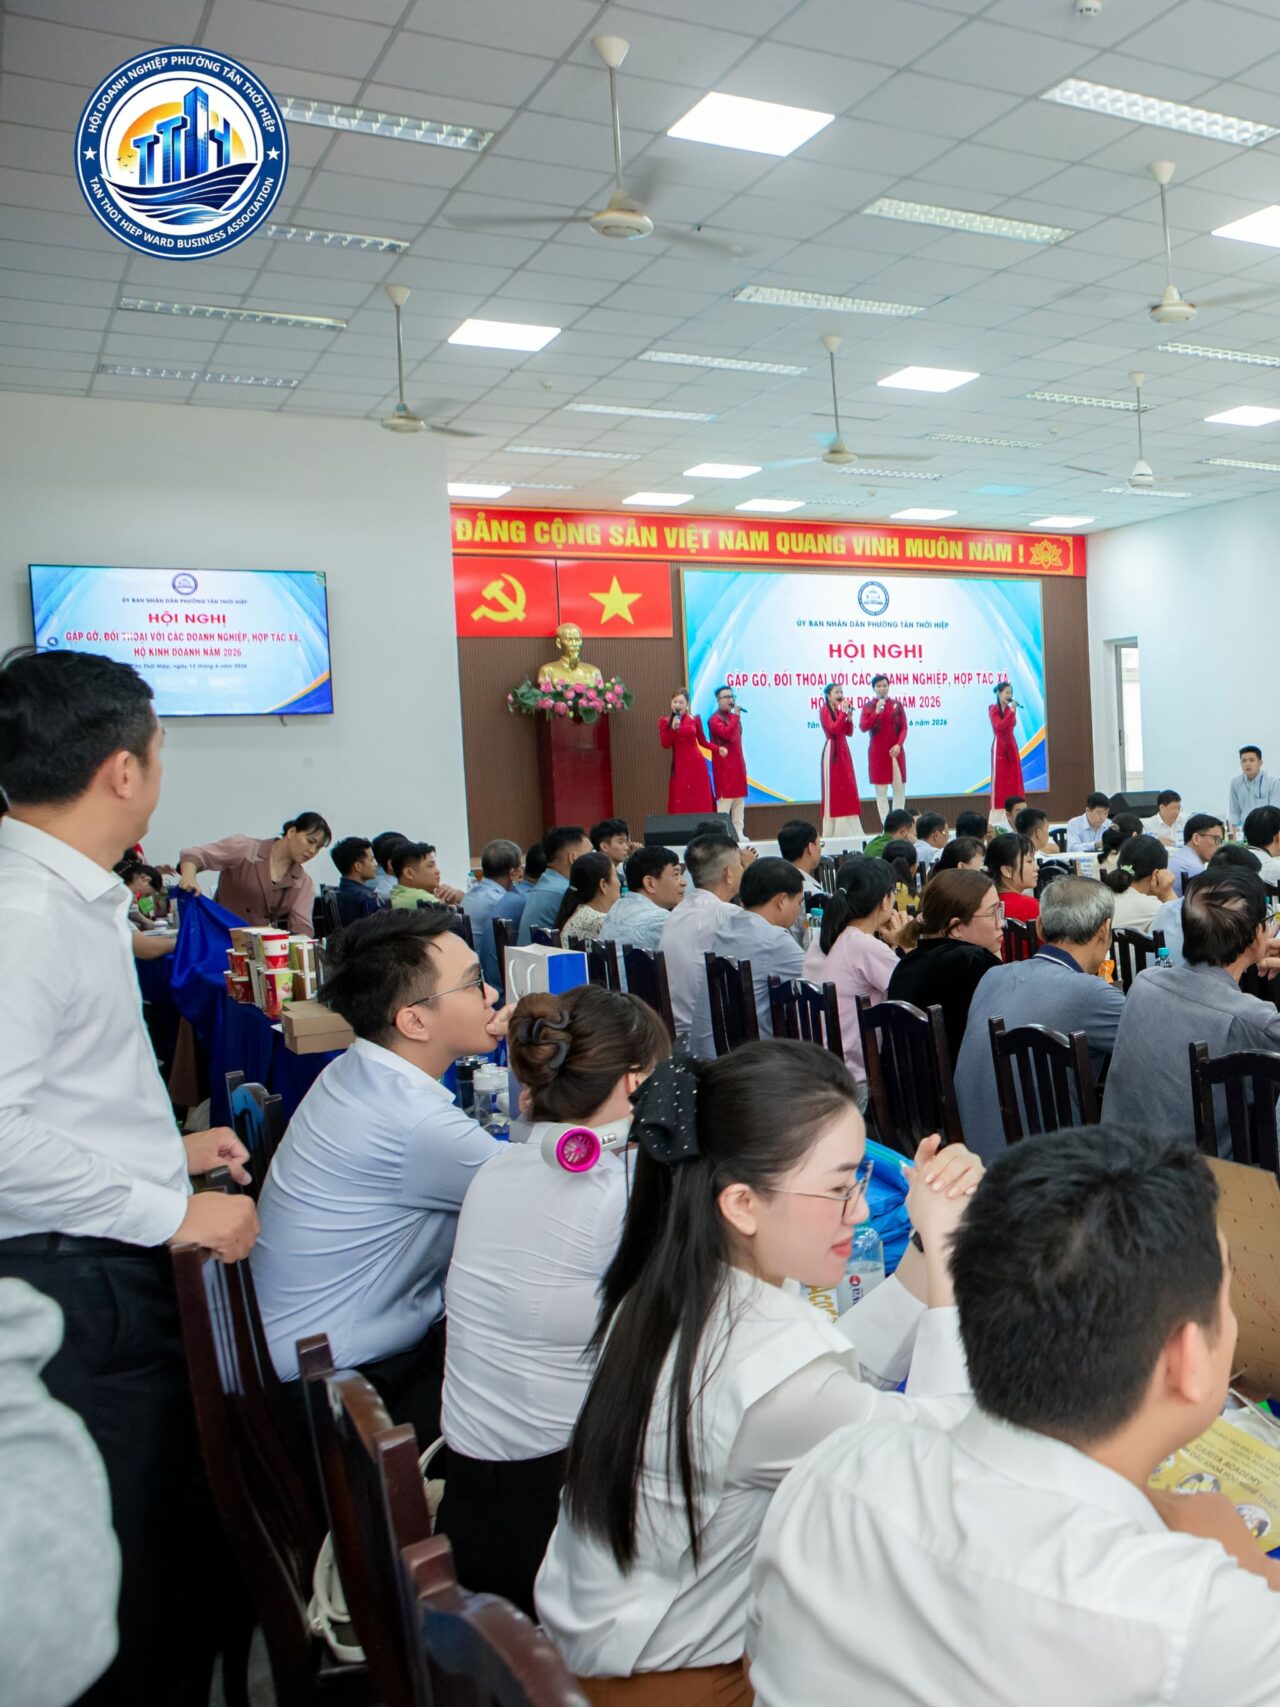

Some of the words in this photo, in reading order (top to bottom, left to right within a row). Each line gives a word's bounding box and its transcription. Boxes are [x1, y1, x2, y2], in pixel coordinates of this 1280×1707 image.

[454, 512, 526, 544] ĐẢNG
[534, 517, 602, 549] CỘNG
[608, 518, 658, 548] SẢN
[664, 524, 712, 554] VIỆT
[718, 529, 770, 552] NAM
[776, 530, 846, 555] QUANG
[852, 537, 899, 558] VINH
[905, 536, 964, 560] MUÔN
[968, 541, 1012, 563] NĂM
[148, 610, 178, 626] HỘI
[184, 614, 226, 628] NGHỊ
[186, 632, 214, 642] DOANH
[149, 648, 170, 656] KINH
[172, 648, 200, 656] DOANH
[224, 648, 242, 656] 2026
[828, 640, 865, 662] HỘI
[874, 644, 923, 663] NGHỊ
[920, 696, 940, 708] 2026
[931, 718, 948, 726] 2026
